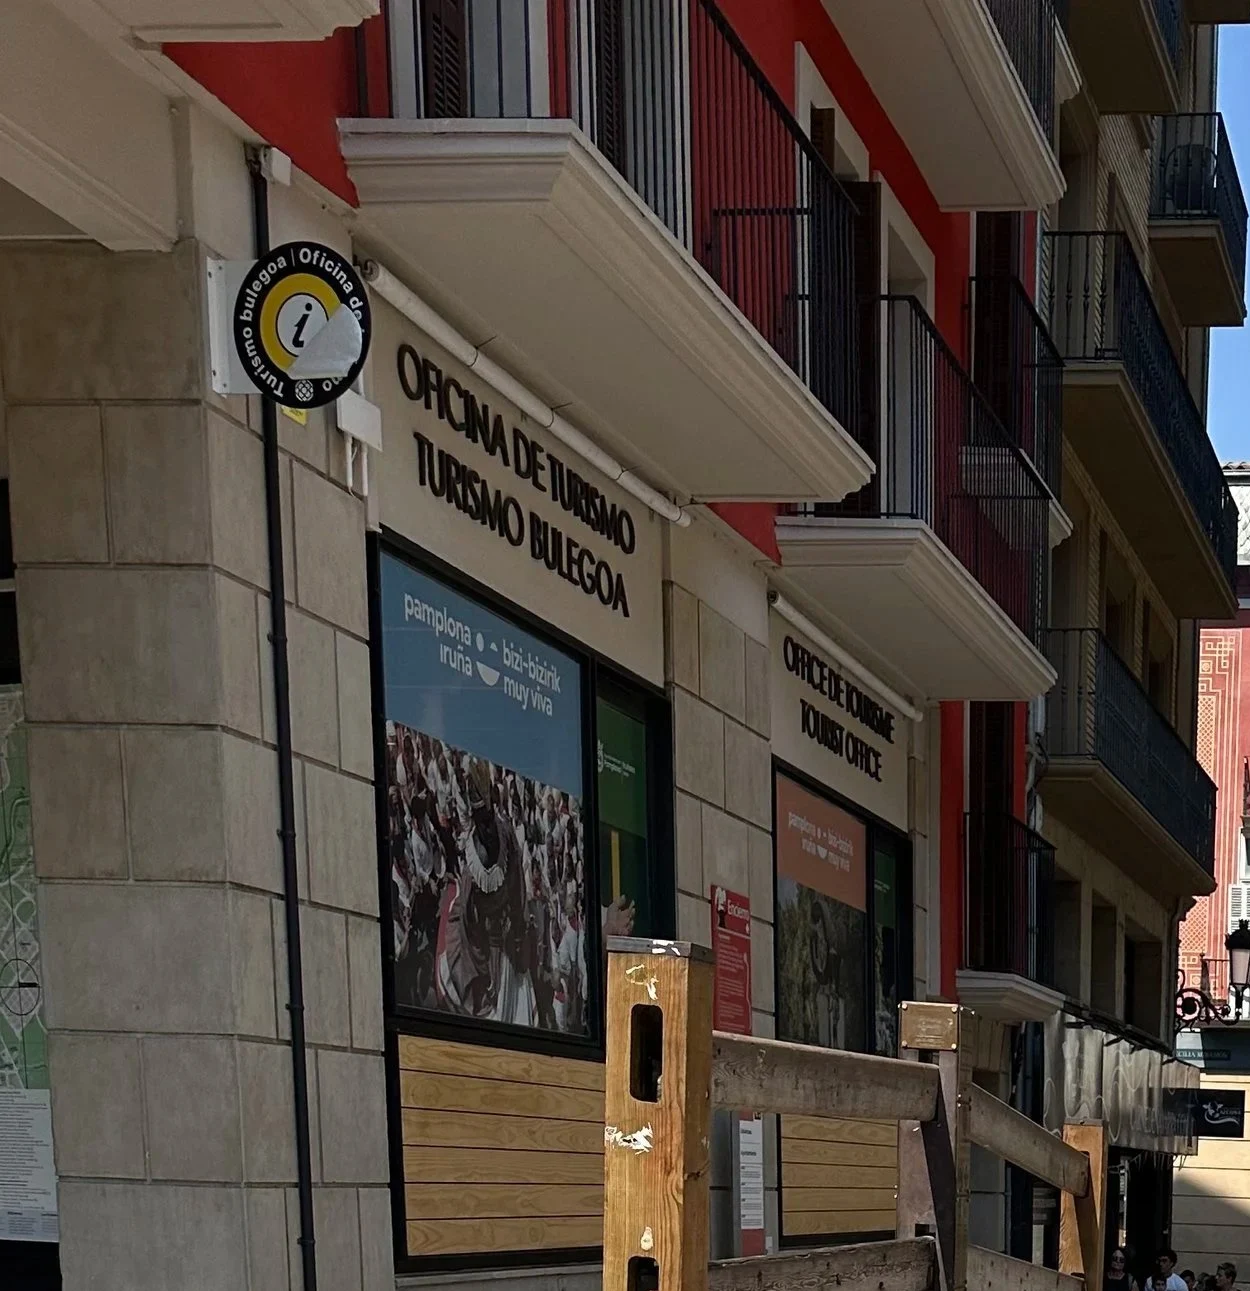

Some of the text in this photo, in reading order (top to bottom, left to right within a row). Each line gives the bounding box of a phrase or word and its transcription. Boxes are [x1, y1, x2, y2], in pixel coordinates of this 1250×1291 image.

[299, 247, 355, 294] Oficina
[239, 255, 287, 398] Turismo bulegoa
[397, 344, 636, 555] OFICINA DE TURISMO
[413, 431, 630, 617] TURISMO BULEGOA
[404, 593, 472, 646] pamplona
[502, 639, 561, 693] bizi-bizirik
[504, 676, 553, 717] muy viva
[783, 635, 896, 745] OFFICE DE TOURISME
[800, 698, 883, 783] TOURIST OFFICE
